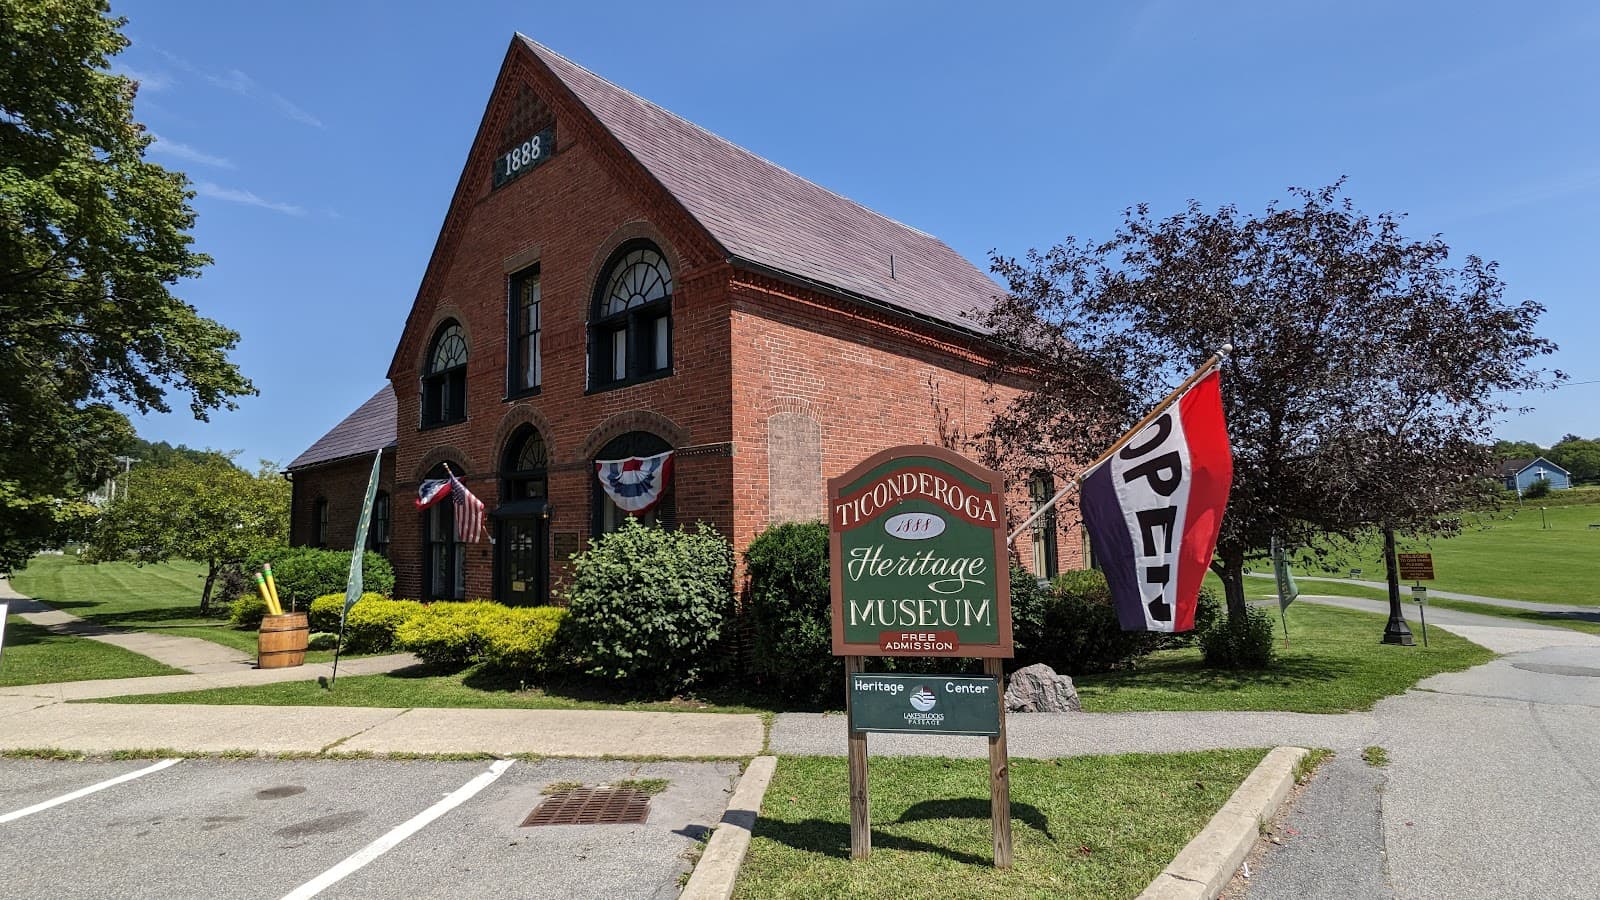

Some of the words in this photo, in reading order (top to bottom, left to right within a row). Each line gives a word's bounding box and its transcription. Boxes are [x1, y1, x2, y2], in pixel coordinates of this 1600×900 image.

[505, 135, 541, 176] 1888
[836, 472, 998, 526] TICONDEROGA
[896, 518, 931, 532] 1888
[1119, 412, 1183, 622] OPEN
[848, 543, 987, 594] Heritage
[850, 599, 991, 627] MUSEUM
[885, 641, 953, 651] ADMISSION
[901, 633, 936, 642] FREE
[855, 680, 905, 696] Heritage
[945, 682, 989, 694] Center
